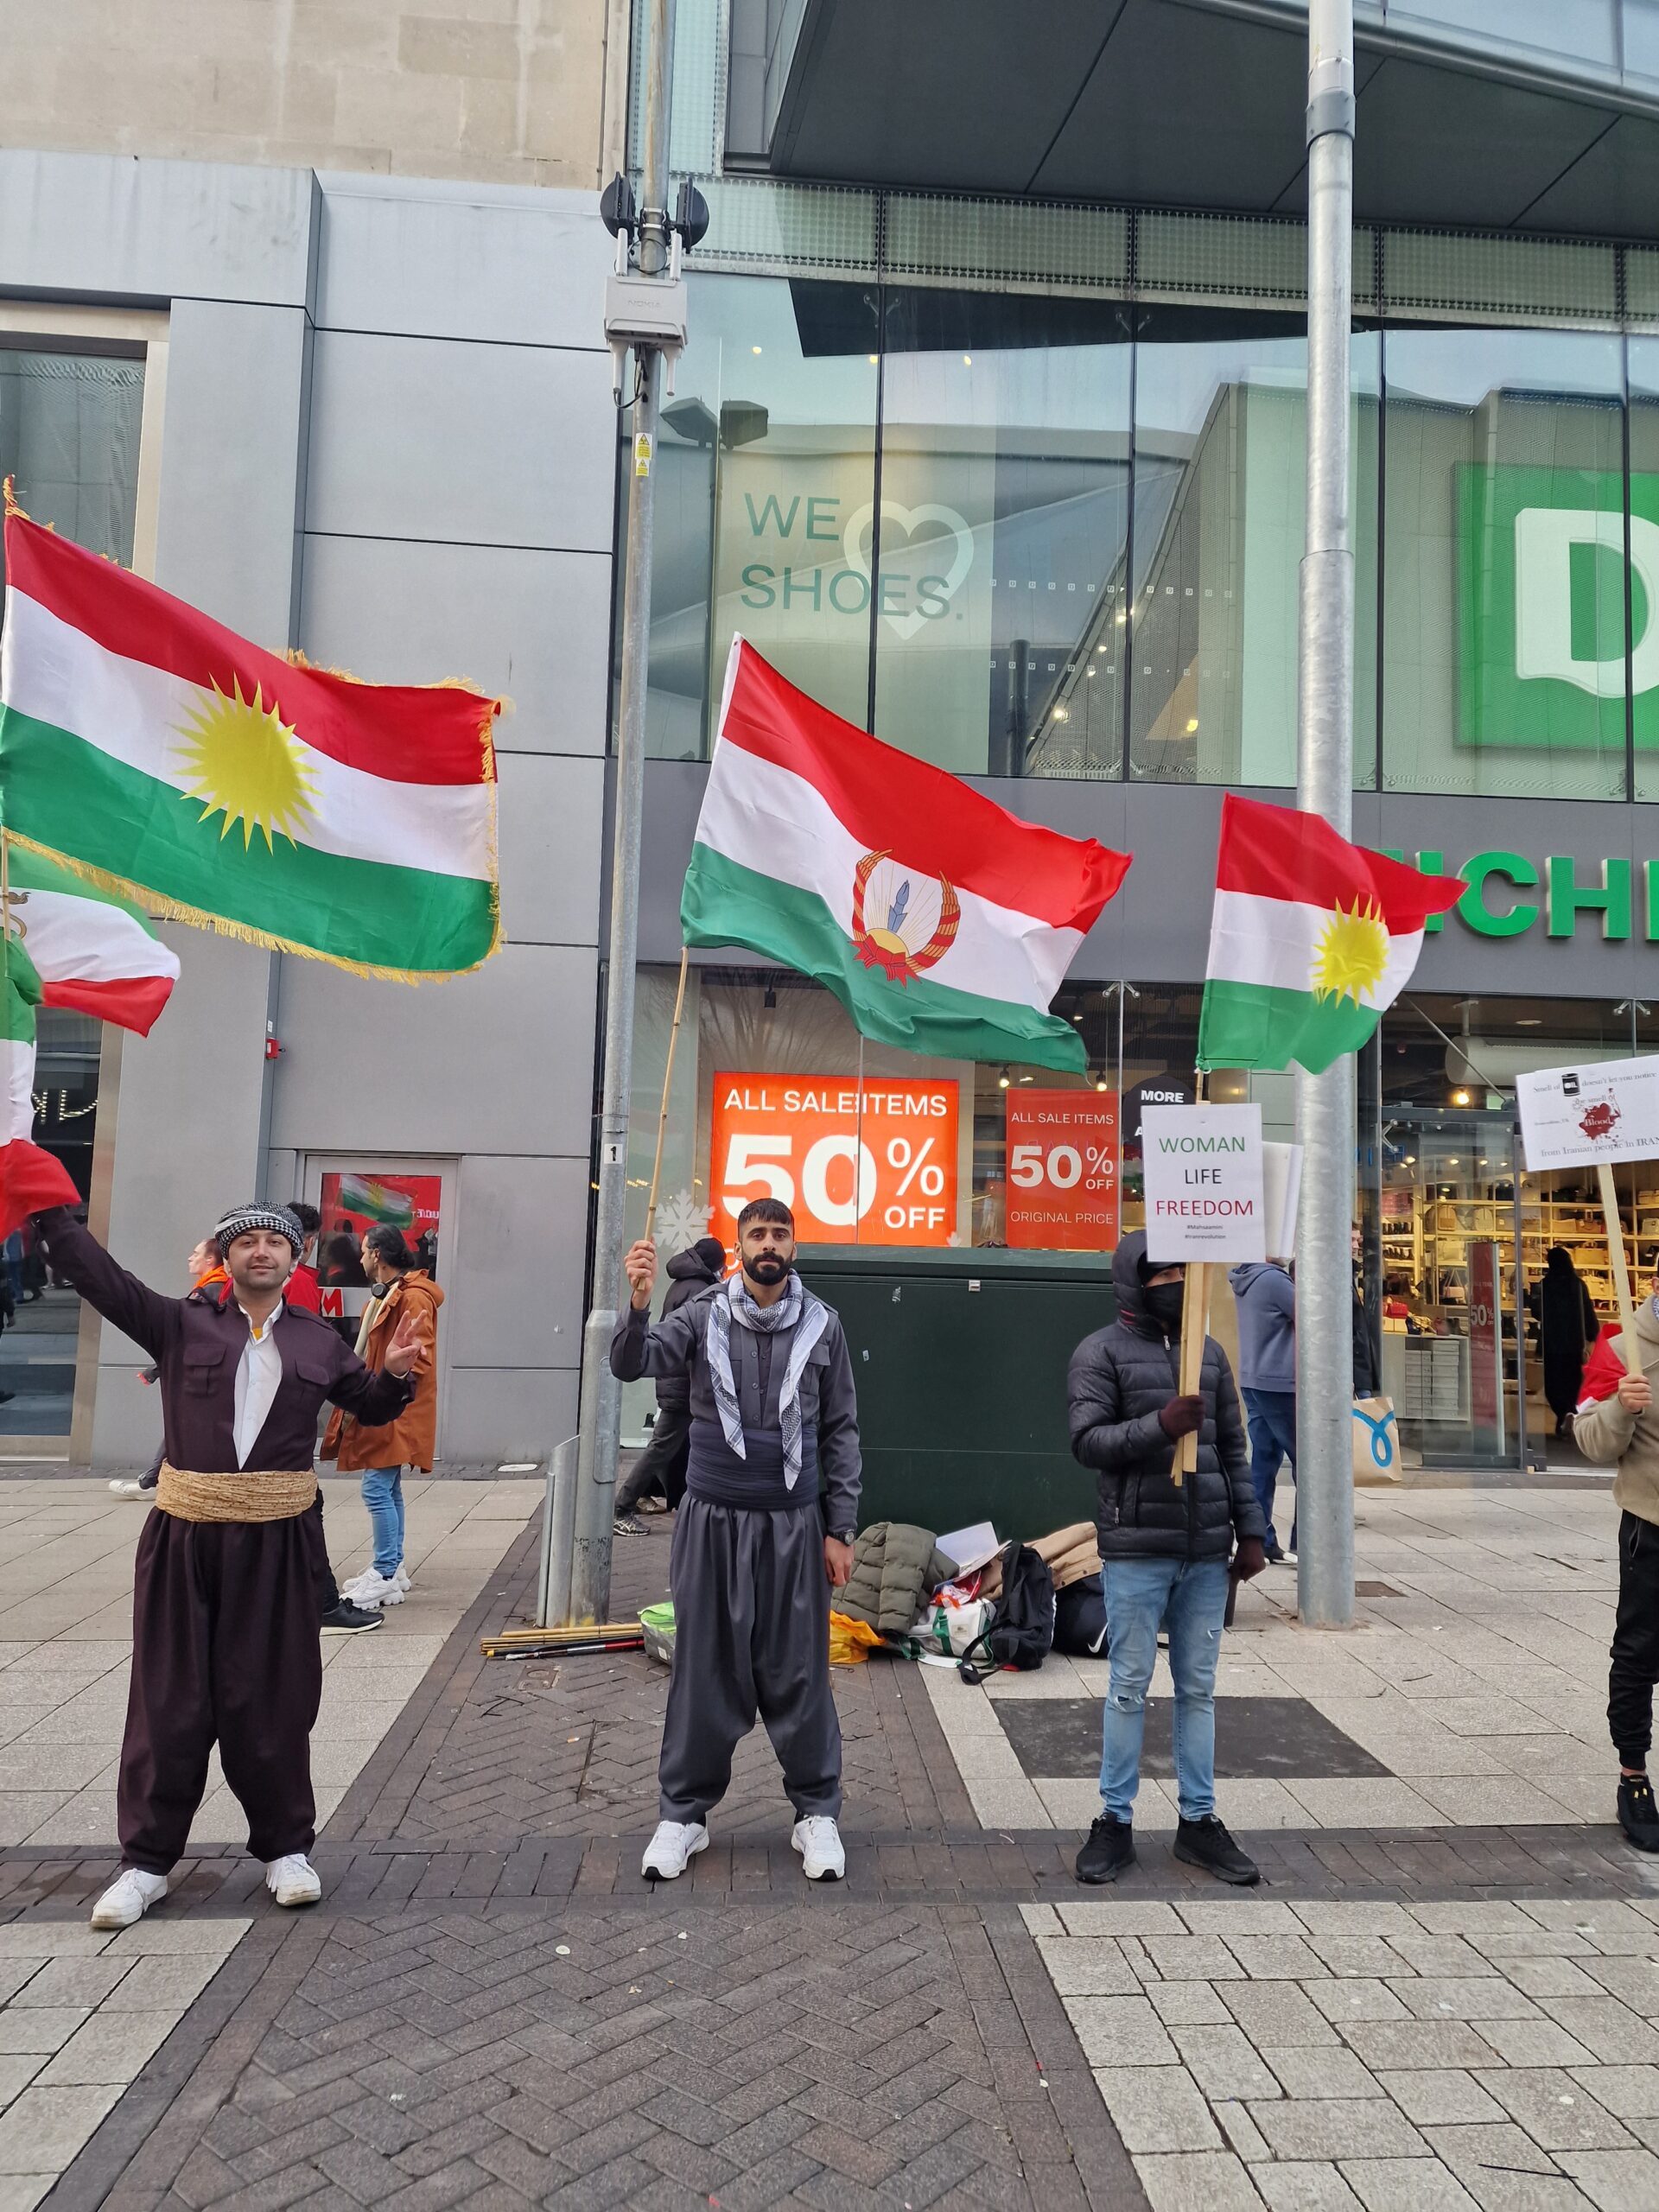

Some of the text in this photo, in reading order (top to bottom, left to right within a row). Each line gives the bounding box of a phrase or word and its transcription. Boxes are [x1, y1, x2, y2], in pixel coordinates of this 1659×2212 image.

[744, 492, 841, 542] WE
[1515, 506, 1659, 699] D
[1141, 1090, 1185, 1103] MORE
[1534, 1084, 1553, 1093] Smell
[724, 1088, 777, 1111] ALL
[1011, 1112, 1115, 1125] ALL SALE ITEMS
[1585, 1116, 1611, 1127] Blood
[1159, 1136, 1245, 1153] WOMAN
[610, 1146, 617, 1162] 1
[1086, 1179, 1115, 1191] OFF
[1185, 1169, 1223, 1185] LIFE
[1156, 1200, 1254, 1216] FREEDOM
[885, 1206, 946, 1230] OFF
[1011, 1211, 1114, 1224] ORIGINAL PRICE
